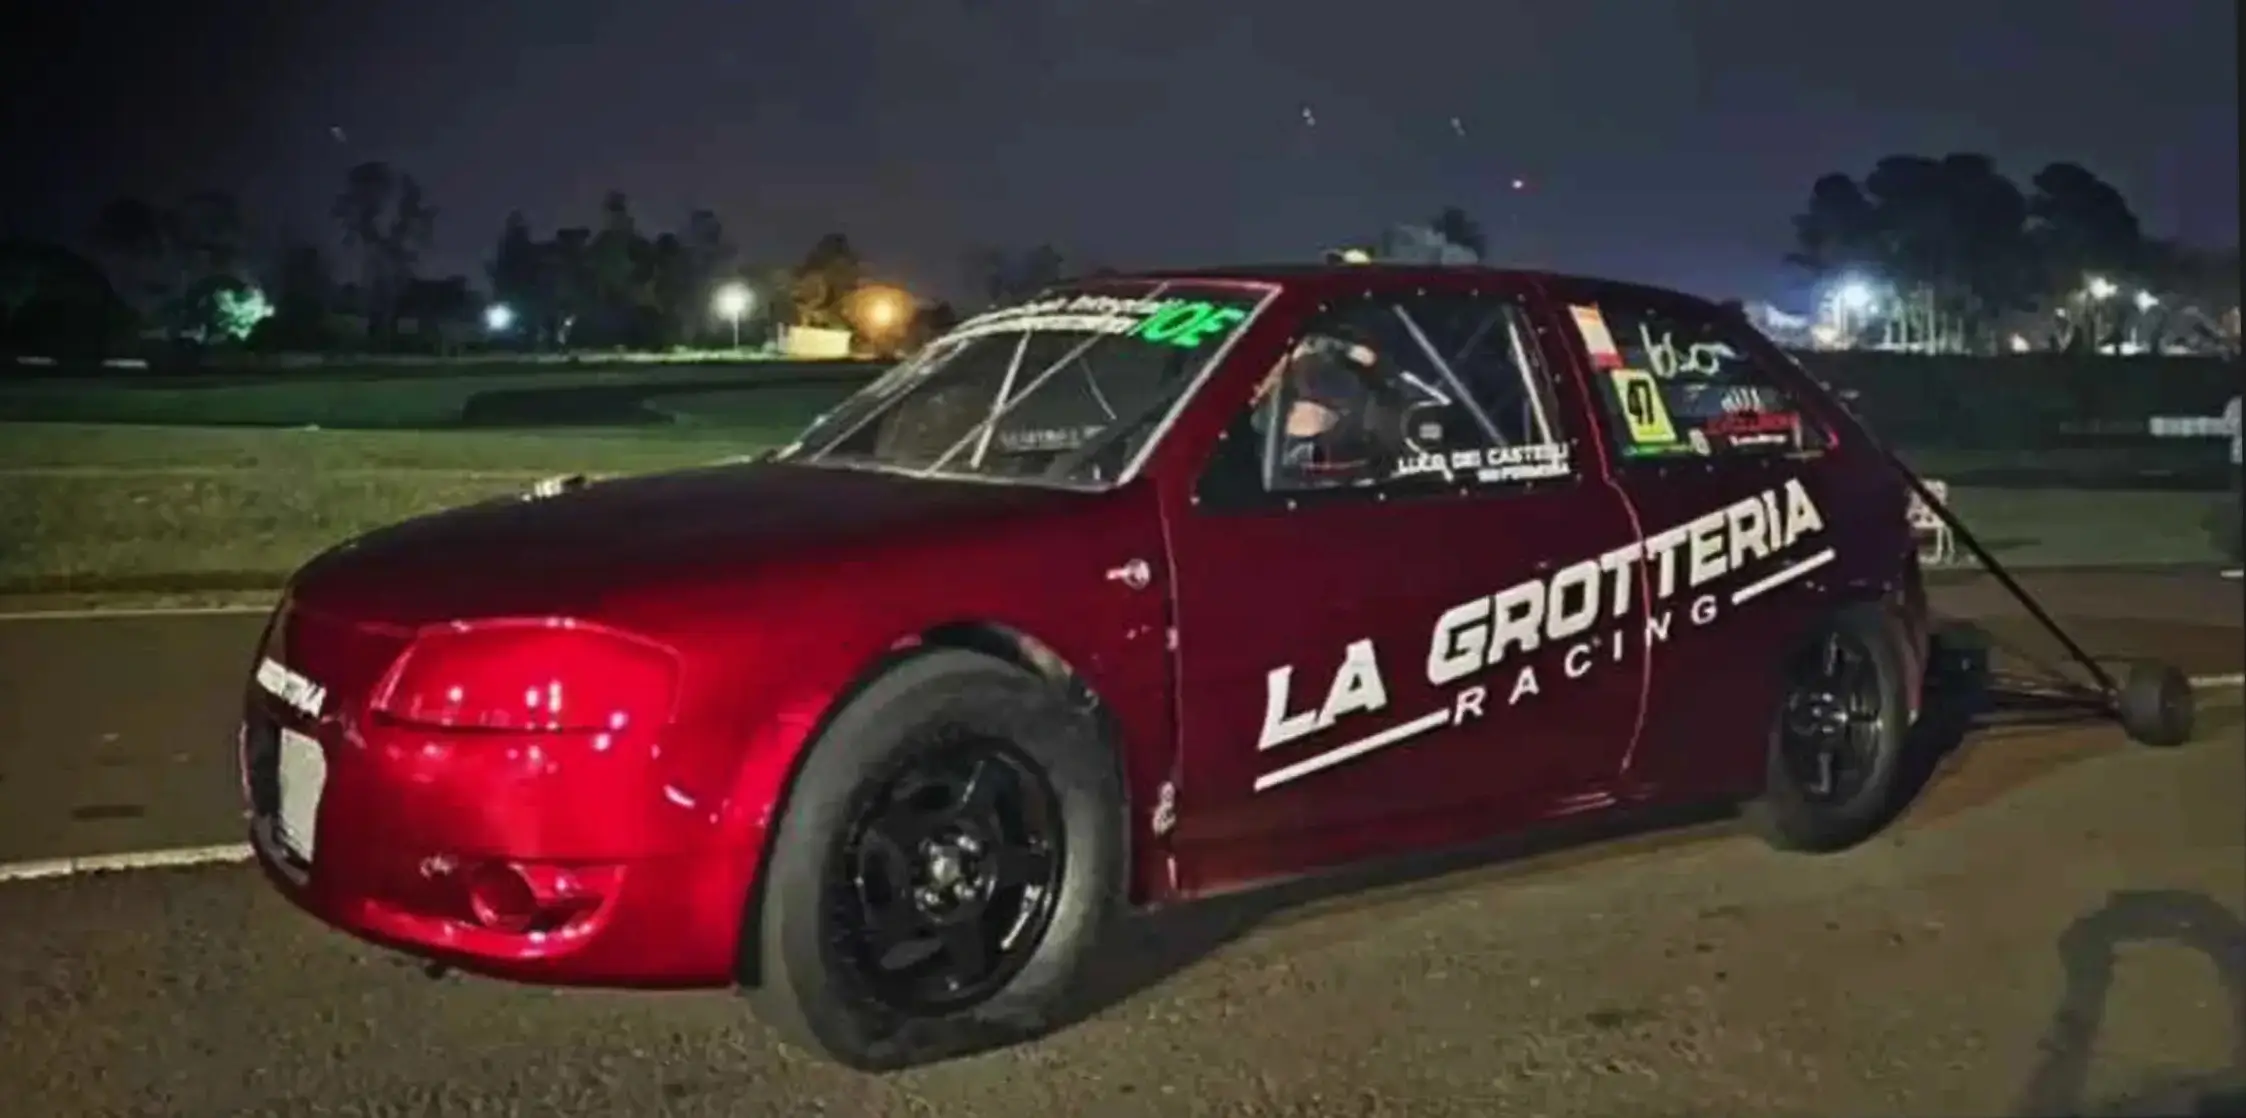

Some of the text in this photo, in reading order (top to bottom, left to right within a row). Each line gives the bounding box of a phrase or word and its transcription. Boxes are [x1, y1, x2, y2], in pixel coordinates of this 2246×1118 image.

[1257, 478, 1824, 750] LA GROTTERIA
[1453, 595, 1718, 726] RACING
